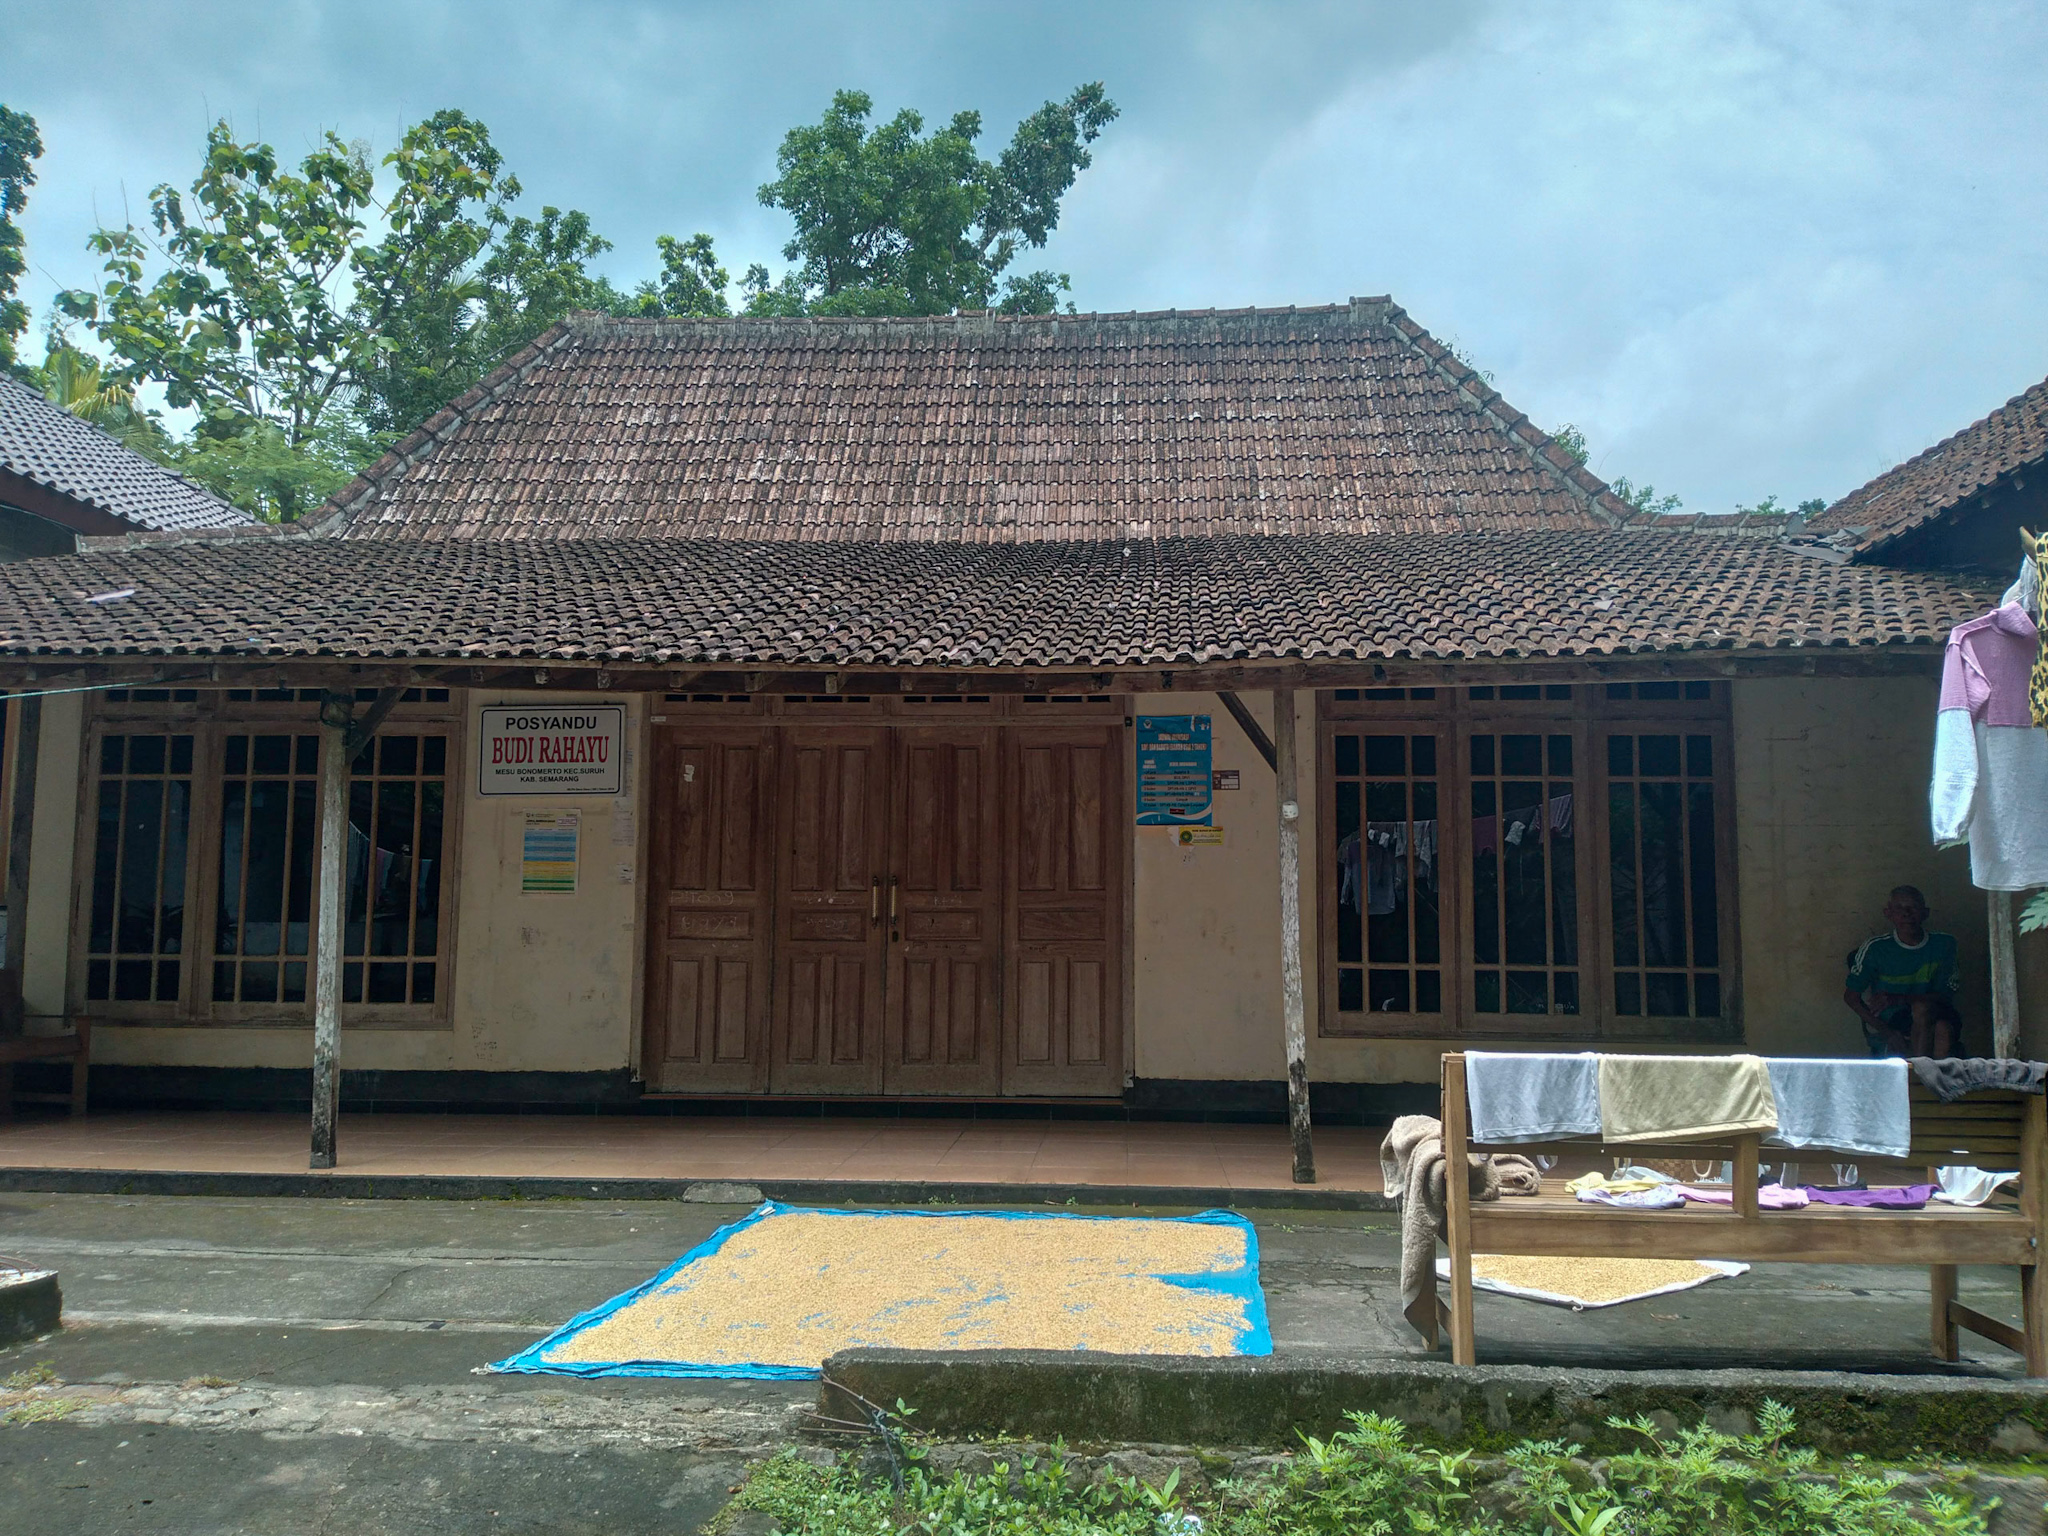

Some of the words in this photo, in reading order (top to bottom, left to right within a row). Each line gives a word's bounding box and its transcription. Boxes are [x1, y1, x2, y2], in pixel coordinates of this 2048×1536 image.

[506, 716, 597, 730] POSYANDU
[492, 736, 534, 764] BUDI
[539, 736, 609, 763] RAHAYU
